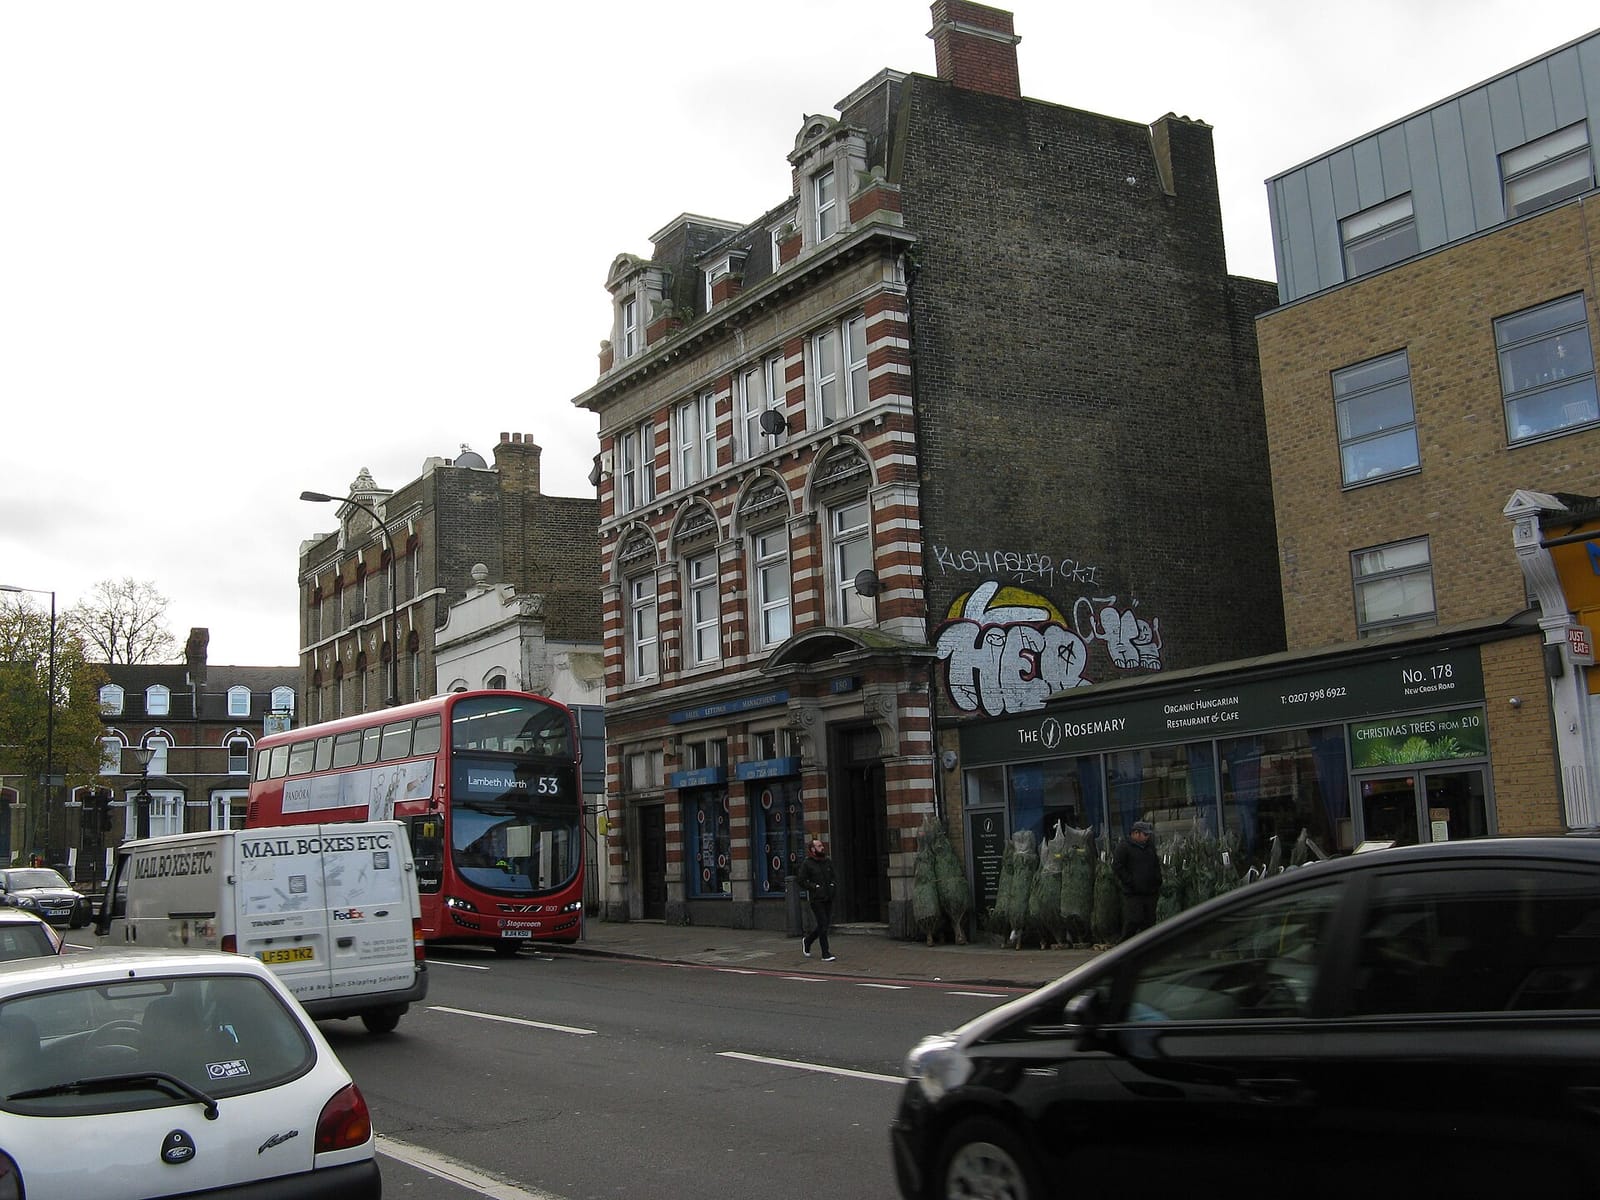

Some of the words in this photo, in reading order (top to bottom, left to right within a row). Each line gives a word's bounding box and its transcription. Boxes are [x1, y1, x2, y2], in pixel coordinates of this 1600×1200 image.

[1569, 630, 1584, 642] JUST
[1573, 642, 1585, 653] EAT
[1402, 668, 1426, 684] No.
[1430, 664, 1453, 680] 178
[1288, 693, 1308, 703] 0207
[1309, 689, 1325, 701] 998
[1326, 687, 1346, 698] 6922
[1419, 685, 1437, 693] CROSS
[1438, 682, 1455, 690] ROAD
[1164, 702, 1195, 714] ORGANIC
[1196, 696, 1239, 710] HUNGARIAN
[1167, 716, 1210, 729] RESTAURANT
[1211, 712, 1219, 723] &
[1221, 711, 1239, 721] CAFE
[1356, 724, 1407, 740] CHRISTMAS
[1409, 721, 1436, 733] TREES
[1439, 721, 1459, 730] FROM
[1462, 716, 1480, 728] £10
[1018, 729, 1038, 743] THE
[1064, 718, 1126, 738] ROSEMARY
[468, 775, 501, 787] Lambeth
[504, 778, 527, 789] North
[537, 777, 558, 794] 53
[286, 789, 309, 801] PANDORA
[241, 840, 294, 858] MAIL
[296, 837, 355, 855] BOXES
[357, 835, 391, 850] ETC.
[135, 856, 157, 879] MAIL
[158, 852, 191, 877] BOXES
[333, 908, 364, 920] FedEx
[262, 951, 290, 962] LF53
[293, 948, 313, 960] TKZ
